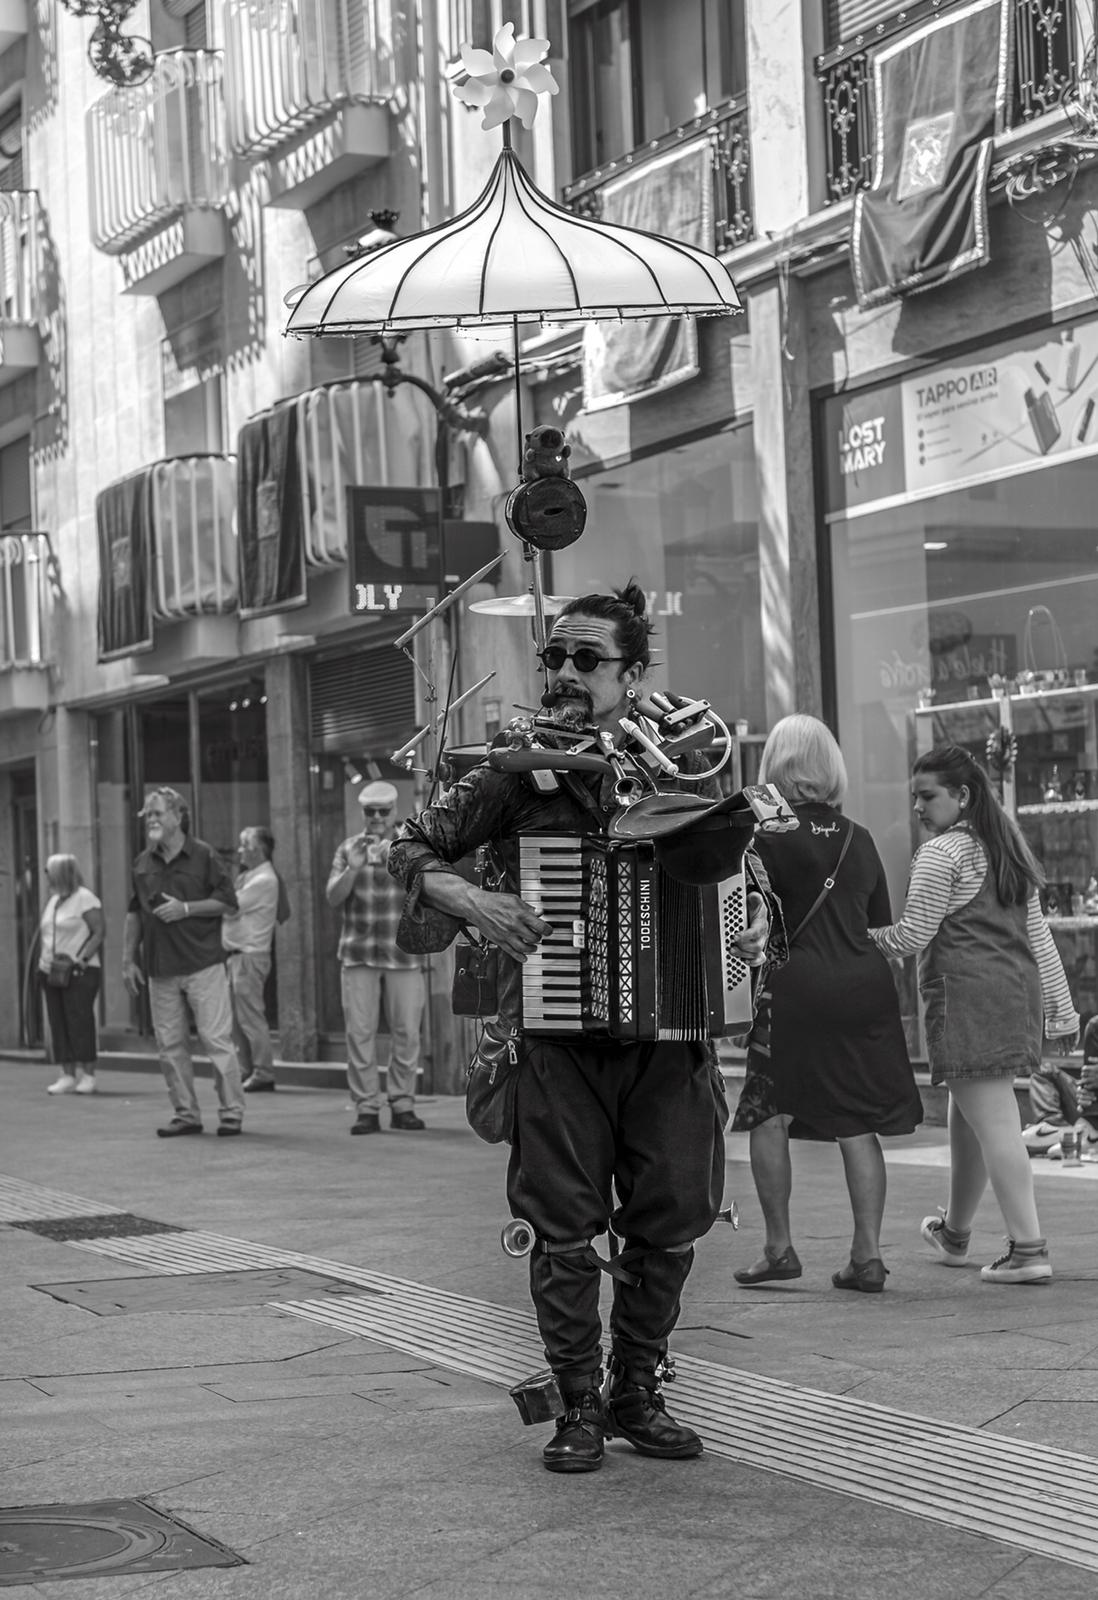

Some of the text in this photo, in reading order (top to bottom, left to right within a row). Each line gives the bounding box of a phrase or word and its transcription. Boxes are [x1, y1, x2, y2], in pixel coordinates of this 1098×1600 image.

[916, 377, 968, 408] TAPPO
[970, 367, 998, 391] AIR
[838, 416, 885, 452] LOST
[840, 441, 886, 475] MARY
[640, 879, 651, 951] TODESCHINI
